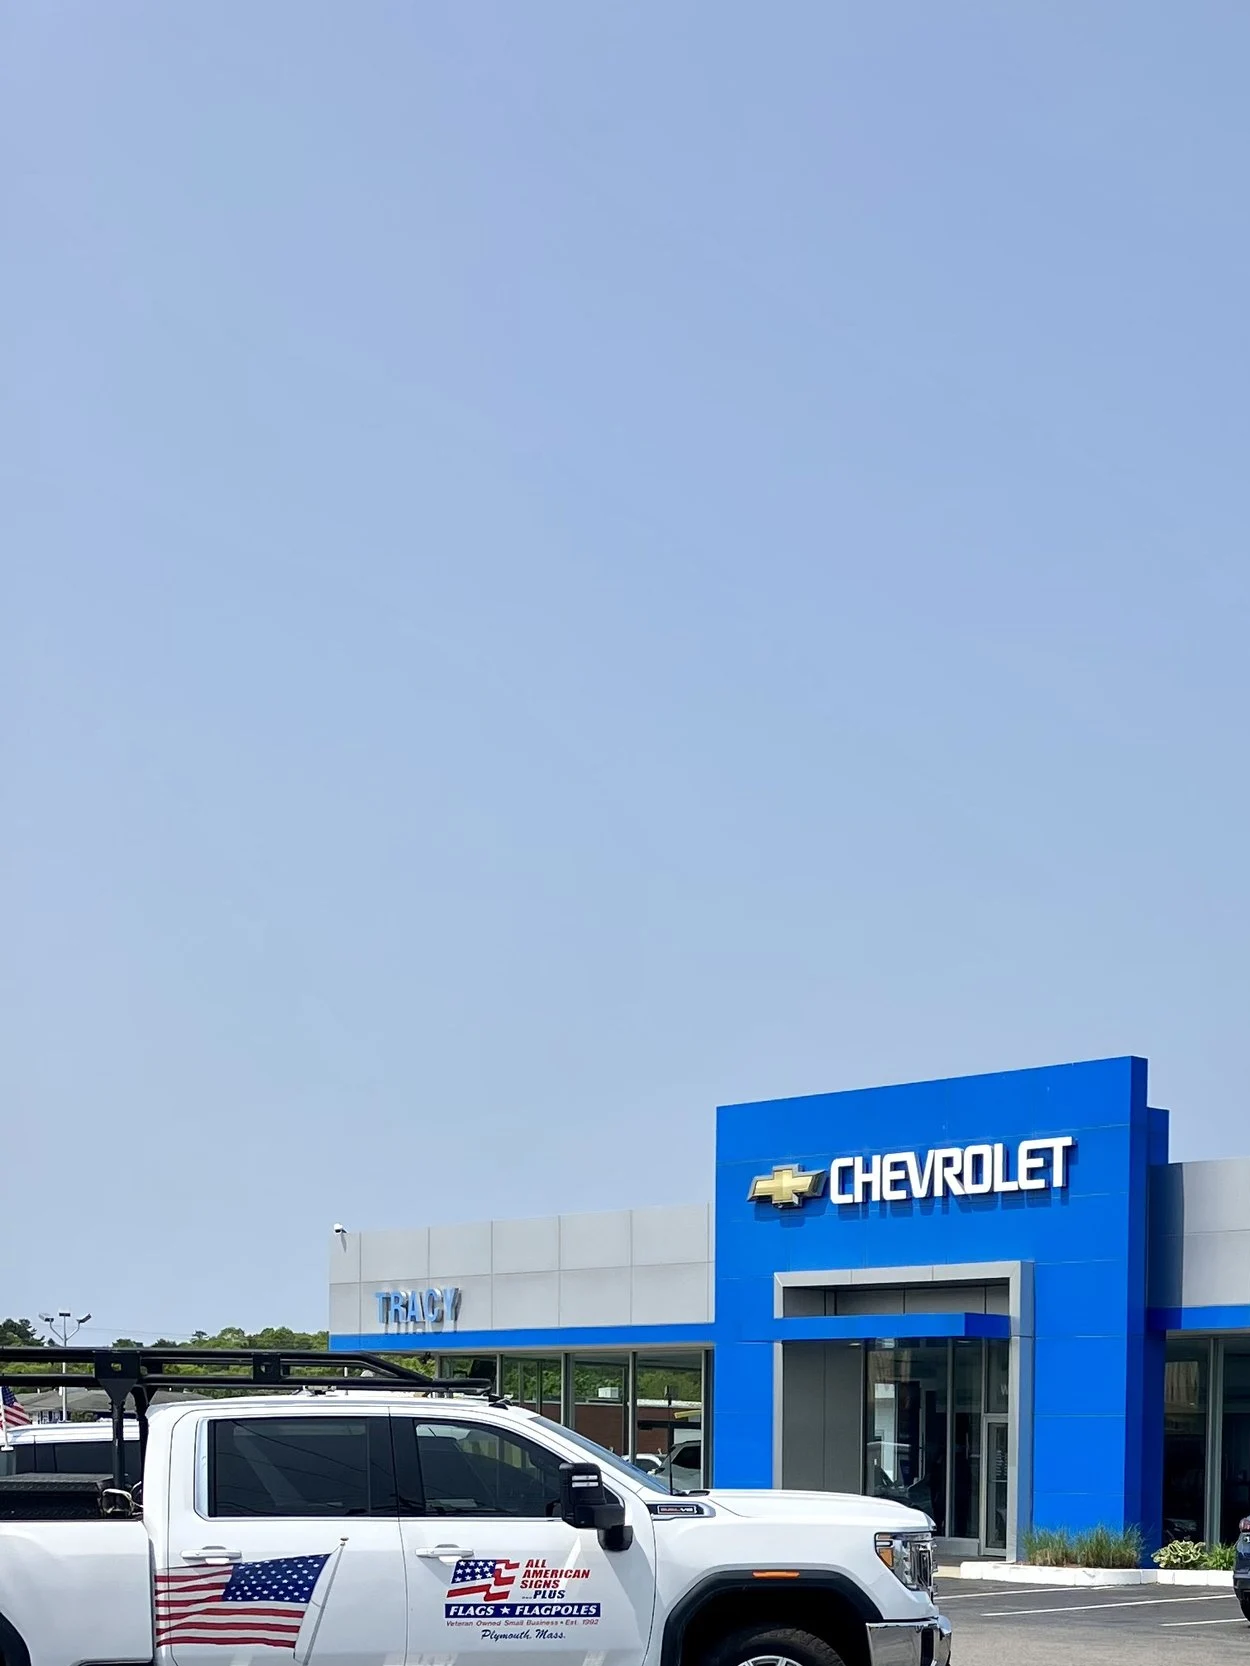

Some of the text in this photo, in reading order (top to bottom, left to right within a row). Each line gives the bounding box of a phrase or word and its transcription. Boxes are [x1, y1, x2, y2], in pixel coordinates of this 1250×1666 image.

[830, 1136, 1073, 1205] CHEVROLET
[374, 1287, 461, 1324] TRACY
[525, 1559, 547, 1568] ALL
[522, 1569, 591, 1579] AMERICAN
[520, 1580, 560, 1589] SIGNS
[449, 1605, 597, 1616] FLAGS FLAGPOLES
